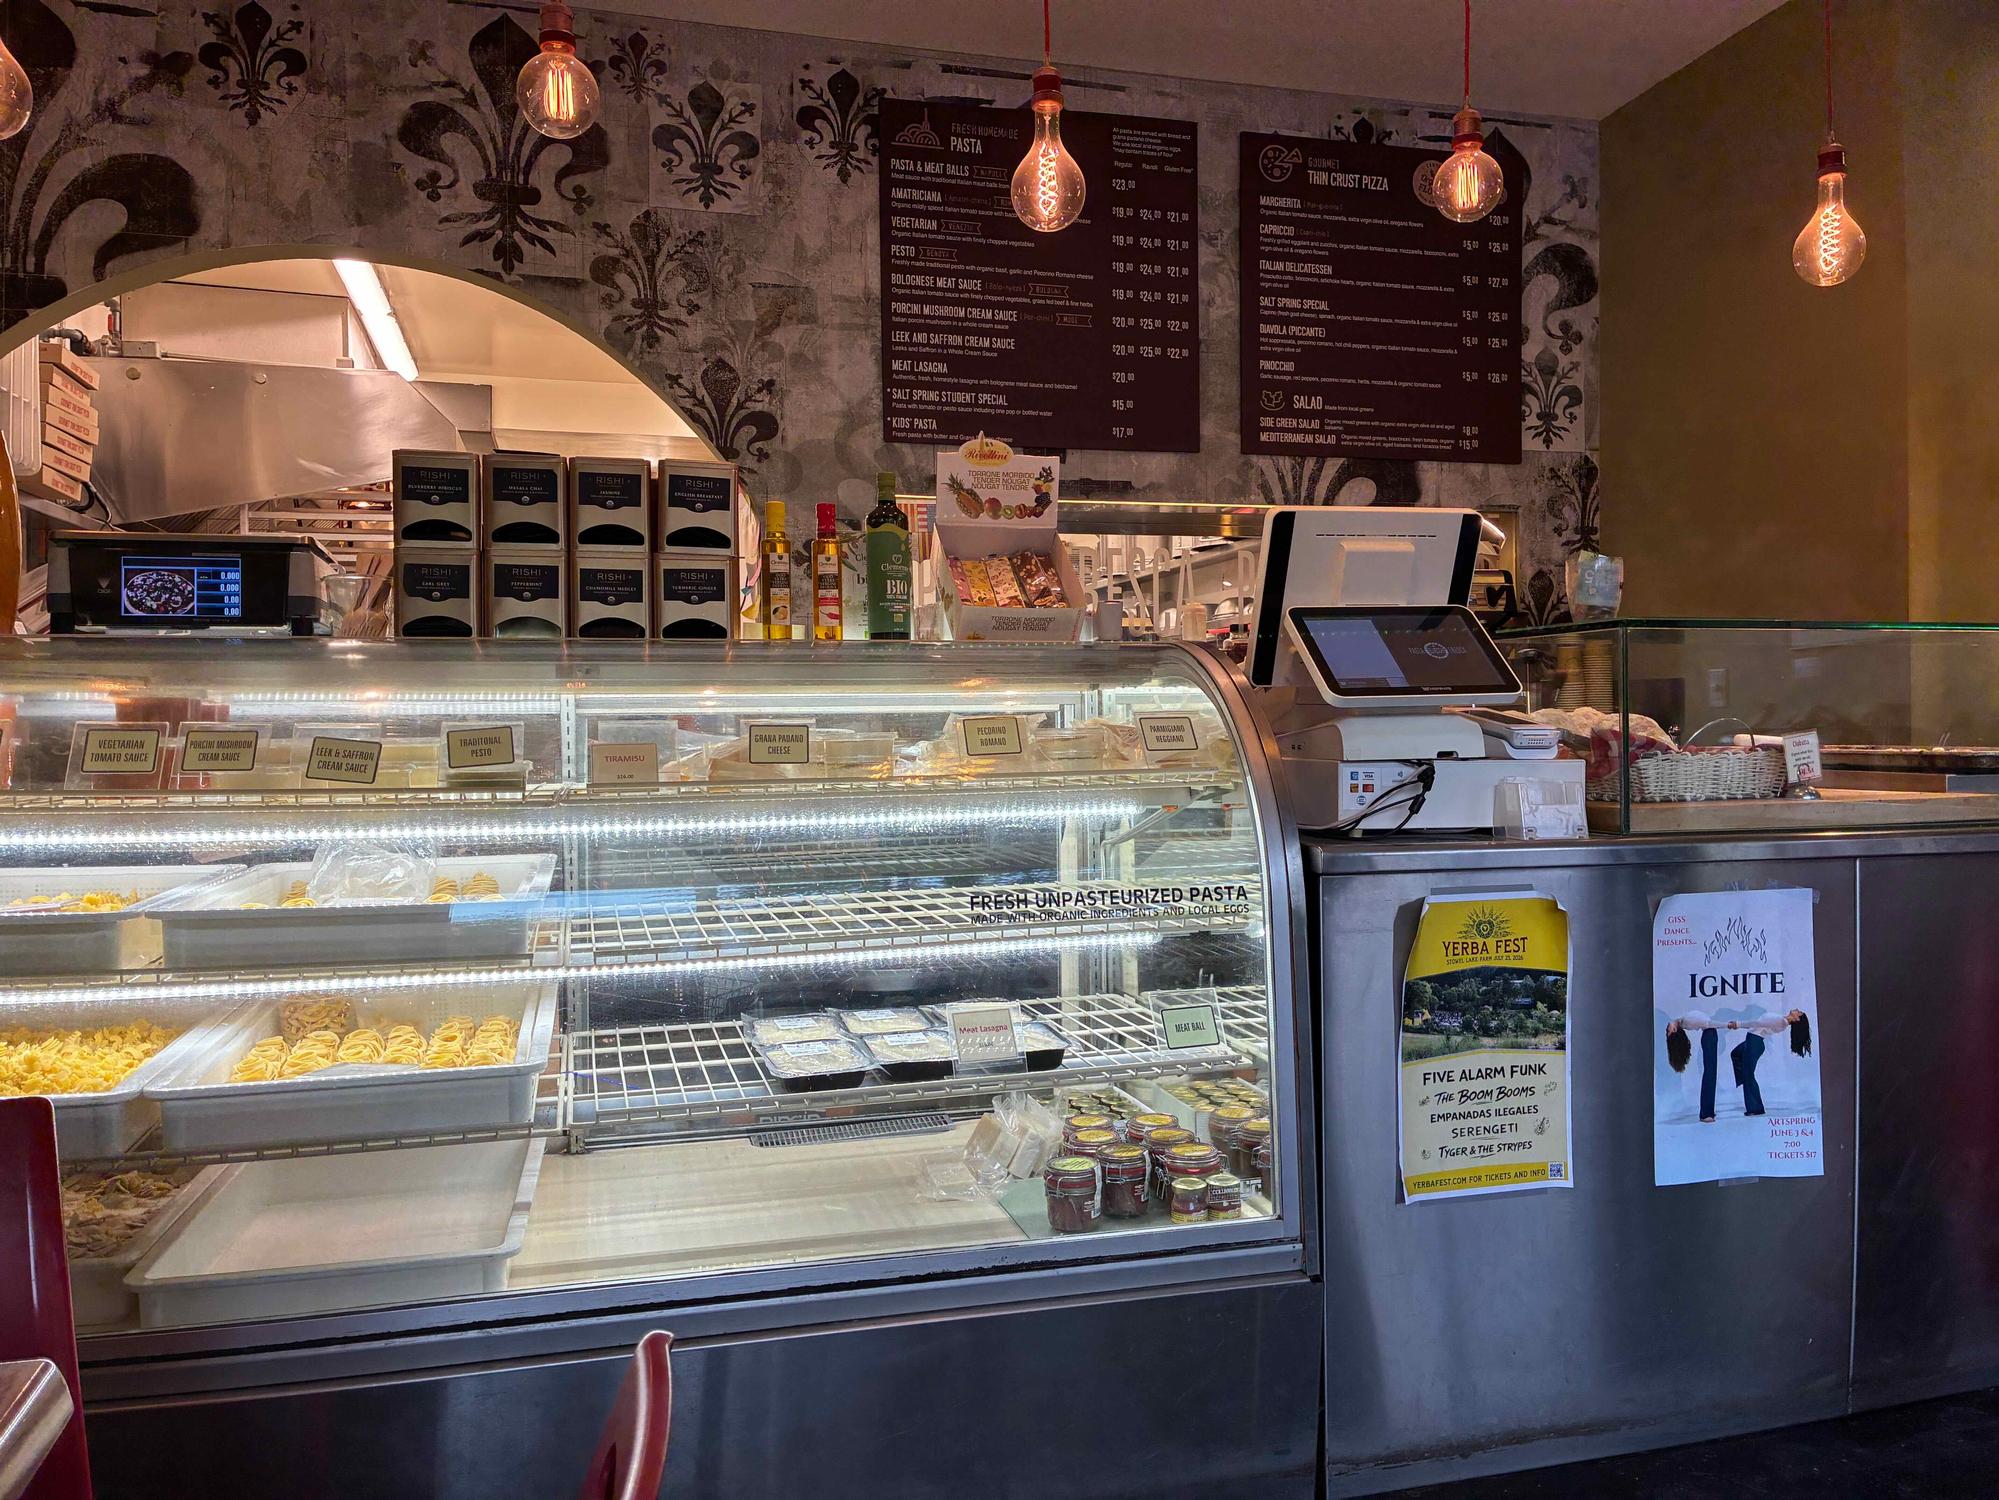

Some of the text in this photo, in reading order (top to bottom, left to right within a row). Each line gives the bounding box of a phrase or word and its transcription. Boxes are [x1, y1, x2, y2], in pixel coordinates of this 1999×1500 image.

[950, 136, 983, 154] PASTA
[890, 158, 970, 177] PASTA & MEAT BALLS
[1308, 157, 1340, 169] GOURMET
[1112, 178, 1136, 190] $23.00
[1307, 170, 1389, 191] THIN CRUST PIZZA
[891, 187, 942, 203] AMATRICIANA
[1259, 195, 1302, 209] MARGHERITA
[1112, 206, 1189, 223] $19.00 $24.00 $21.00
[891, 216, 937, 230] VEGETARIAN
[1259, 224, 1295, 237] CAPRICCIO
[891, 244, 915, 257] PESTO
[1259, 259, 1333, 275] ITALIAN DELICATESSEN
[891, 273, 935, 287] BOLOGNESE
[936, 276, 956, 290] MEAT
[958, 278, 982, 291] SAUCE
[1259, 296, 1330, 311] SALT SPRING SPECIAL
[891, 302, 921, 315] PORCINI
[923, 304, 965, 318] MUSHROOM
[966, 307, 992, 320] CREAM
[994, 309, 1018, 322] SAUCE
[1259, 324, 1326, 338] DIAVOLA (PICCANTE)
[891, 330, 1016, 350] LEEK AND SAFFRON CREAM SAUCE
[891, 359, 948, 374] MEAT LASAGNA
[1259, 360, 1295, 372] PINOCCHIO
[1112, 372, 1135, 383] $20.00
[892, 388, 1009, 406] SALT SPRING STUDENT SPECIAL
[1293, 395, 1323, 410] SALAD
[1112, 399, 1134, 411] $15.00
[913, 418, 937, 430] PASTA
[1259, 417, 1320, 430] SIDE GREEN SALAD
[1112, 427, 1134, 438] $17.00
[1259, 432, 1336, 445] MEDITERRANEAN SALAD
[420, 470, 450, 480] RISHI
[511, 471, 540, 480] RISHI
[596, 476, 624, 485] RISHI
[685, 479, 713, 489] RISHI
[421, 567, 451, 576] RISHI
[512, 568, 541, 576] RISHI
[680, 572, 708, 580] RISHI
[886, 579, 908, 595] BIO
[976, 726, 1007, 735] PECORINO
[1150, 724, 1186, 734] PARMIGIANO
[98, 739, 145, 749] VEGETARIAN
[189, 740, 253, 749] PORCINI MUSHROOM
[754, 734, 804, 743] GRANA PADANO
[980, 737, 1007, 747] ROMANO
[1155, 734, 1185, 744] REGGIANO
[315, 746, 375, 761] LEEK & SAFFRON
[470, 748, 492, 758] PESTO
[767, 745, 791, 755] CHEESE
[90, 752, 149, 762] TOMATO SAUCE
[198, 752, 241, 762] CREAM SAUCE
[604, 755, 645, 763] TIRAMISU
[317, 759, 368, 774] CREAM SAUCE
[970, 885, 1248, 911] FRESH UNPASTEURIZED PASTA
[971, 903, 1250, 925] MADE WITH ORGANIC INGREDIENTS AND LOCAL EGGS
[1668, 915, 1686, 924] GISS
[1664, 927, 1690, 935] DANCE
[1442, 937, 1528, 957] YERBA FEST
[1689, 972, 1785, 998] IGNITE
[958, 1022, 1009, 1036] Meat Lasagna
[1174, 1021, 1205, 1033] MEAT BALL
[1423, 1063, 1547, 1086] FIVE ALARM FUNK
[1435, 1086, 1536, 1105] THE BOOM BOOMS
[1430, 1105, 1539, 1123] EMPANADAS ILEGALES
[1767, 1116, 1816, 1127] ARTSPRING
[1451, 1123, 1518, 1139] SERENGETI
[1770, 1129, 1793, 1138] JUNE
[1795, 1129, 1799, 1137] 3
[1801, 1128, 1809, 1137] &
[1438, 1140, 1533, 1159] TYGER & THE STRYPES
[1767, 1150, 1817, 1160] TICKETS $17
[1412, 1168, 1546, 1189] YERBAFEST.COM FOR TICKETS AND INFO
